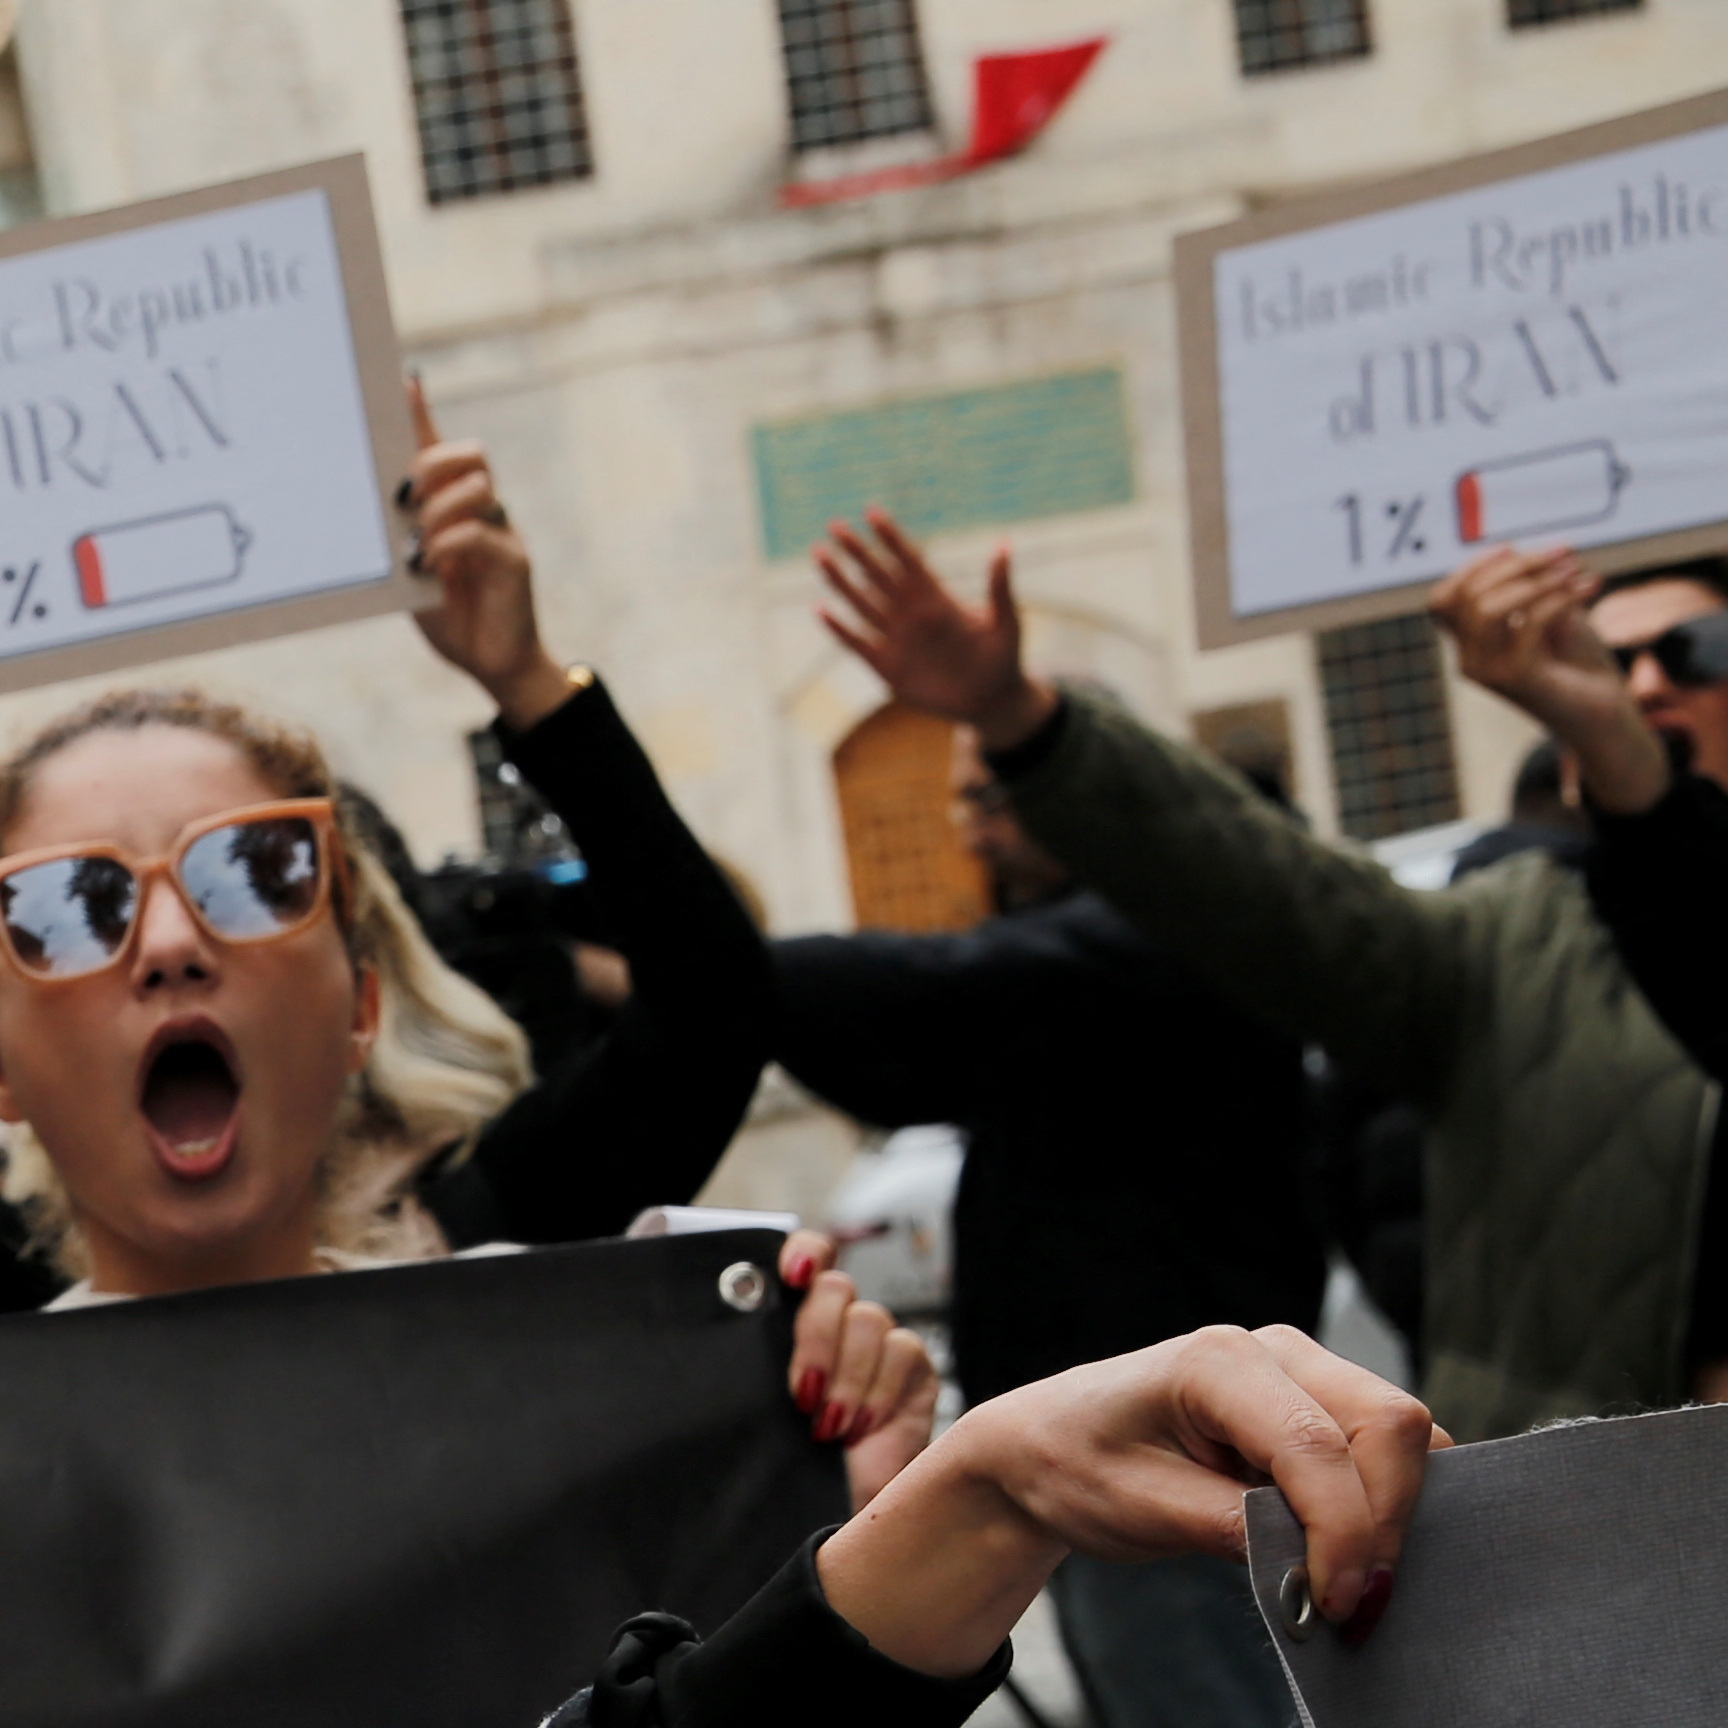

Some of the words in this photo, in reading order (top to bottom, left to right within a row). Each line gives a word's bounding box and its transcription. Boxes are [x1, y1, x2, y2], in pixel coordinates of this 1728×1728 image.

[51, 237, 310, 359] Republic
[1240, 250, 1436, 344] Islamic
[1469, 171, 1726, 299] Republic
[0, 356, 230, 491] IRAN
[1328, 352, 1376, 445] of
[1400, 296, 1620, 428] IRAN
[1334, 489, 1426, 568] 1%
